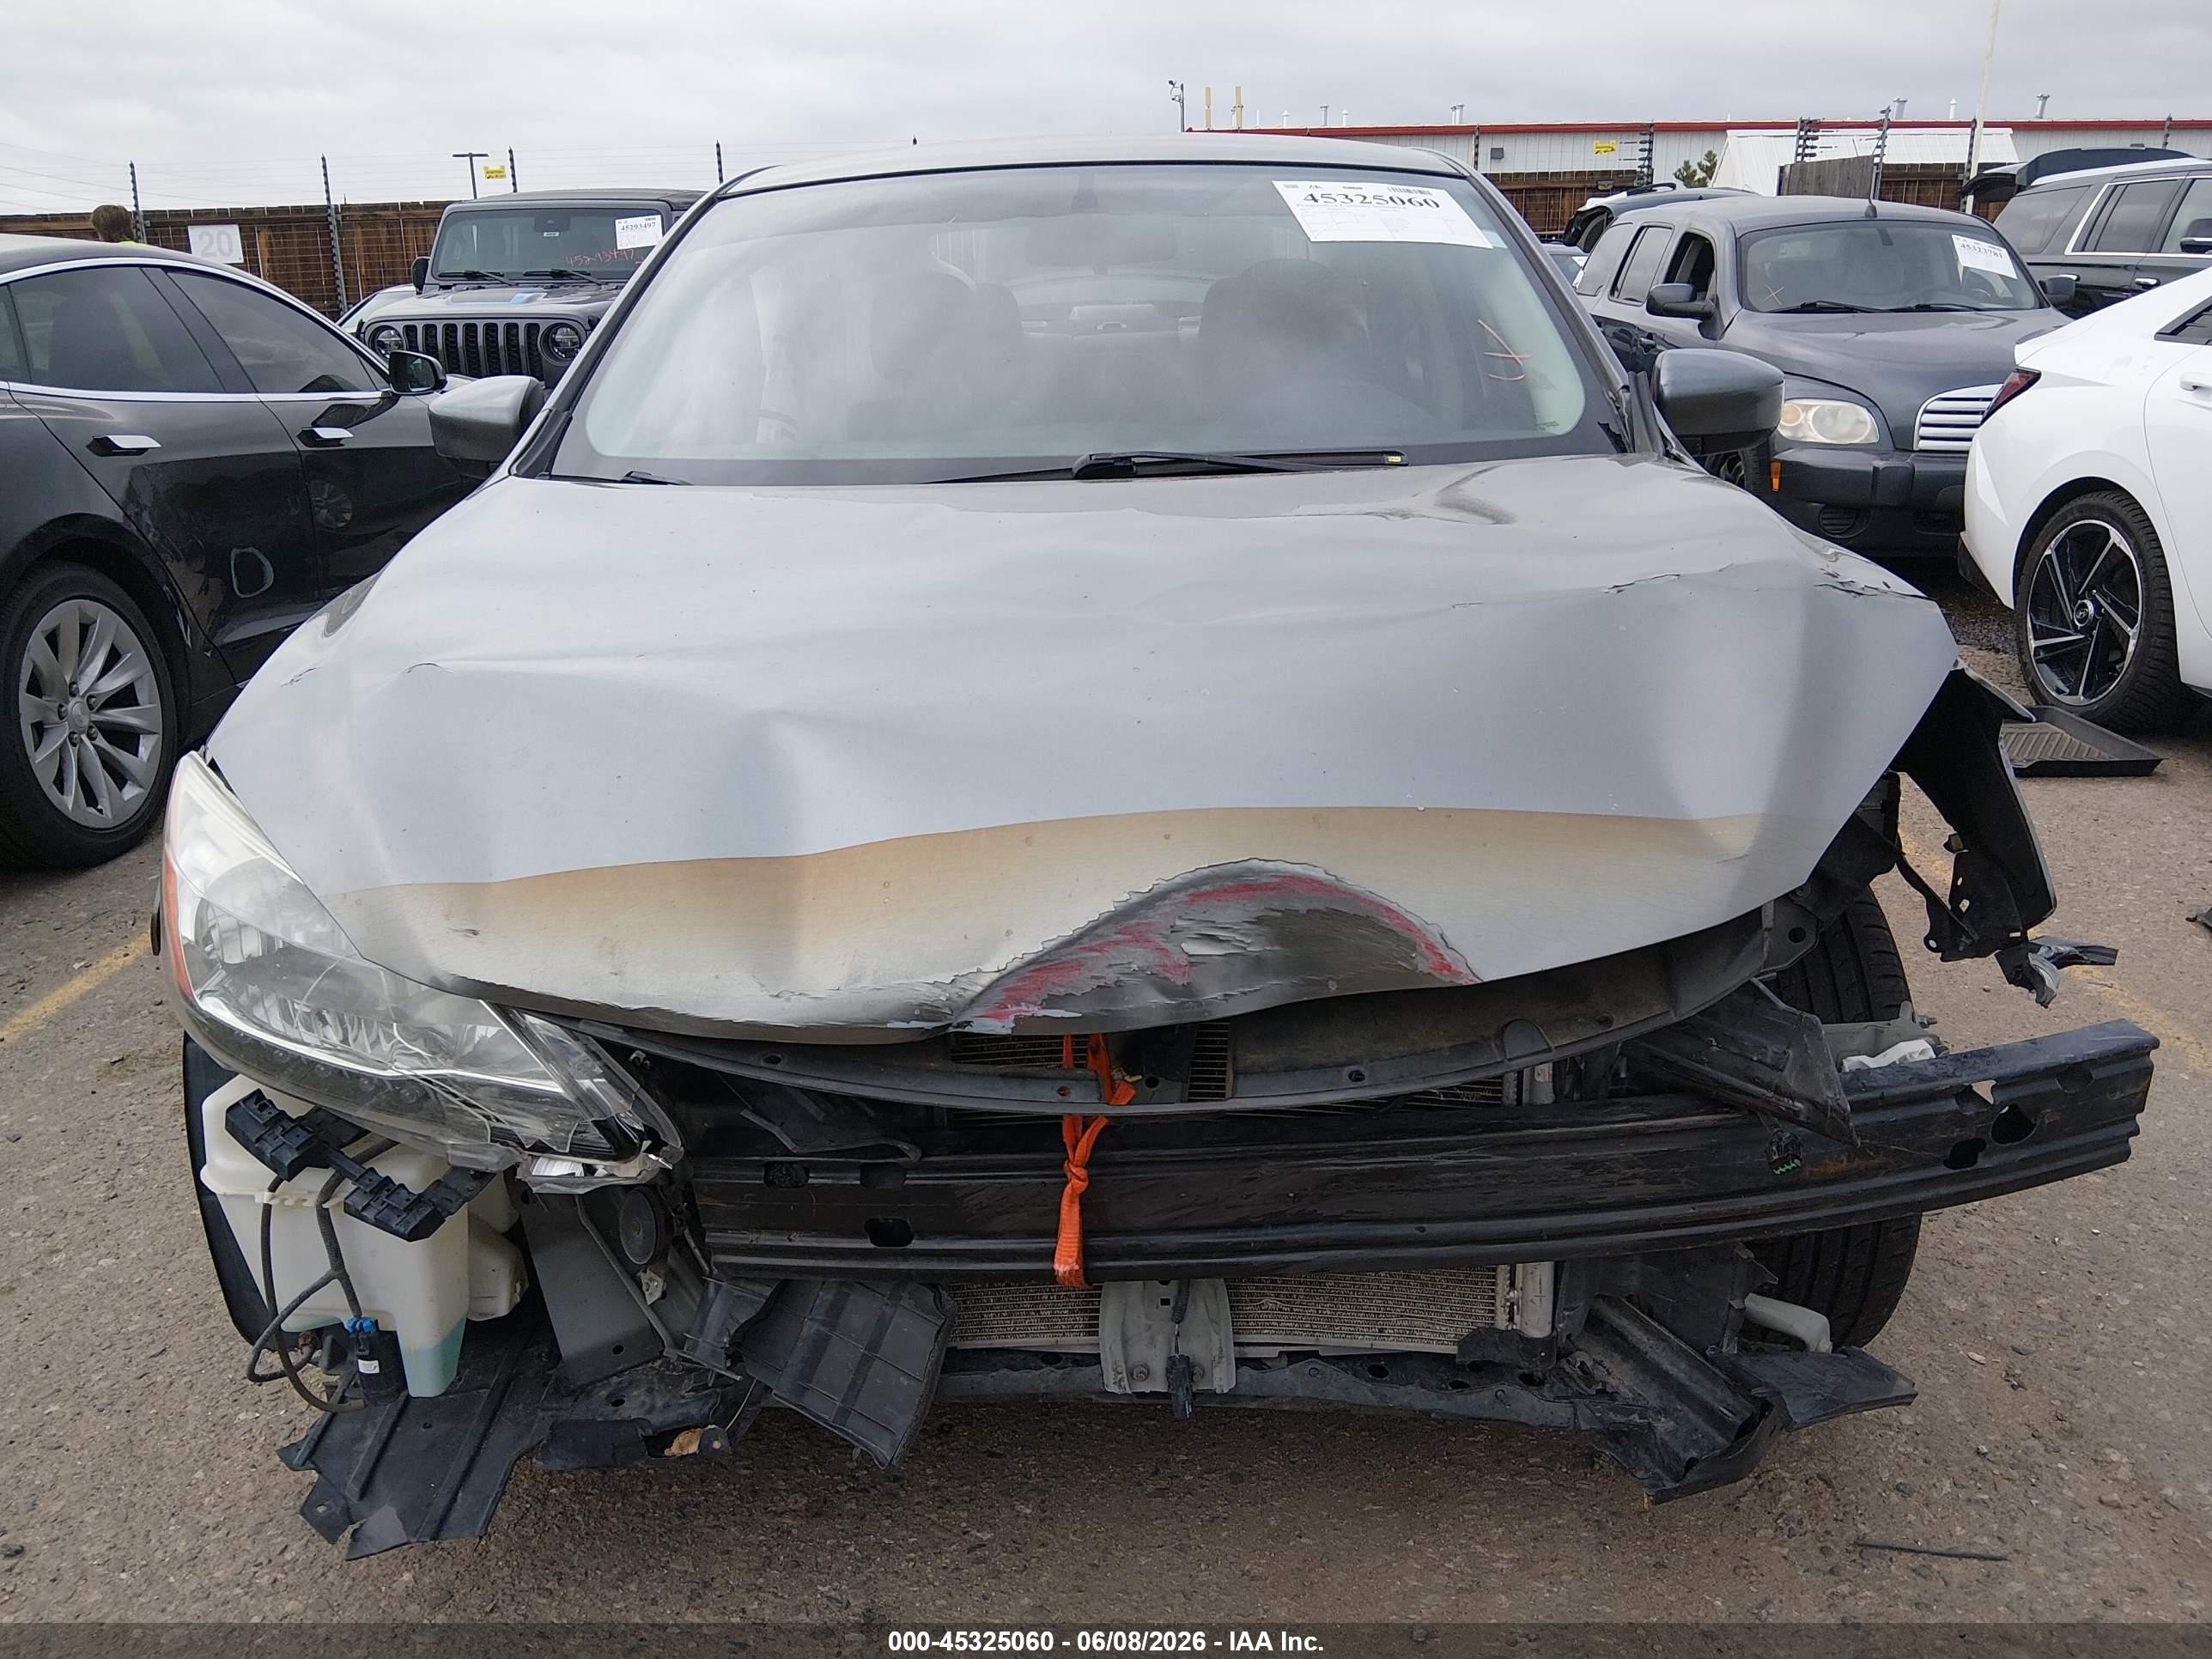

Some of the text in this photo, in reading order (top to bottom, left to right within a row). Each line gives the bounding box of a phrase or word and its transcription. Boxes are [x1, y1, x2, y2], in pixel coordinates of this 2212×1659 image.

[1303, 191, 1441, 210] 45325060
[620, 222, 656, 232] 45293497
[198, 230, 234, 258] 20
